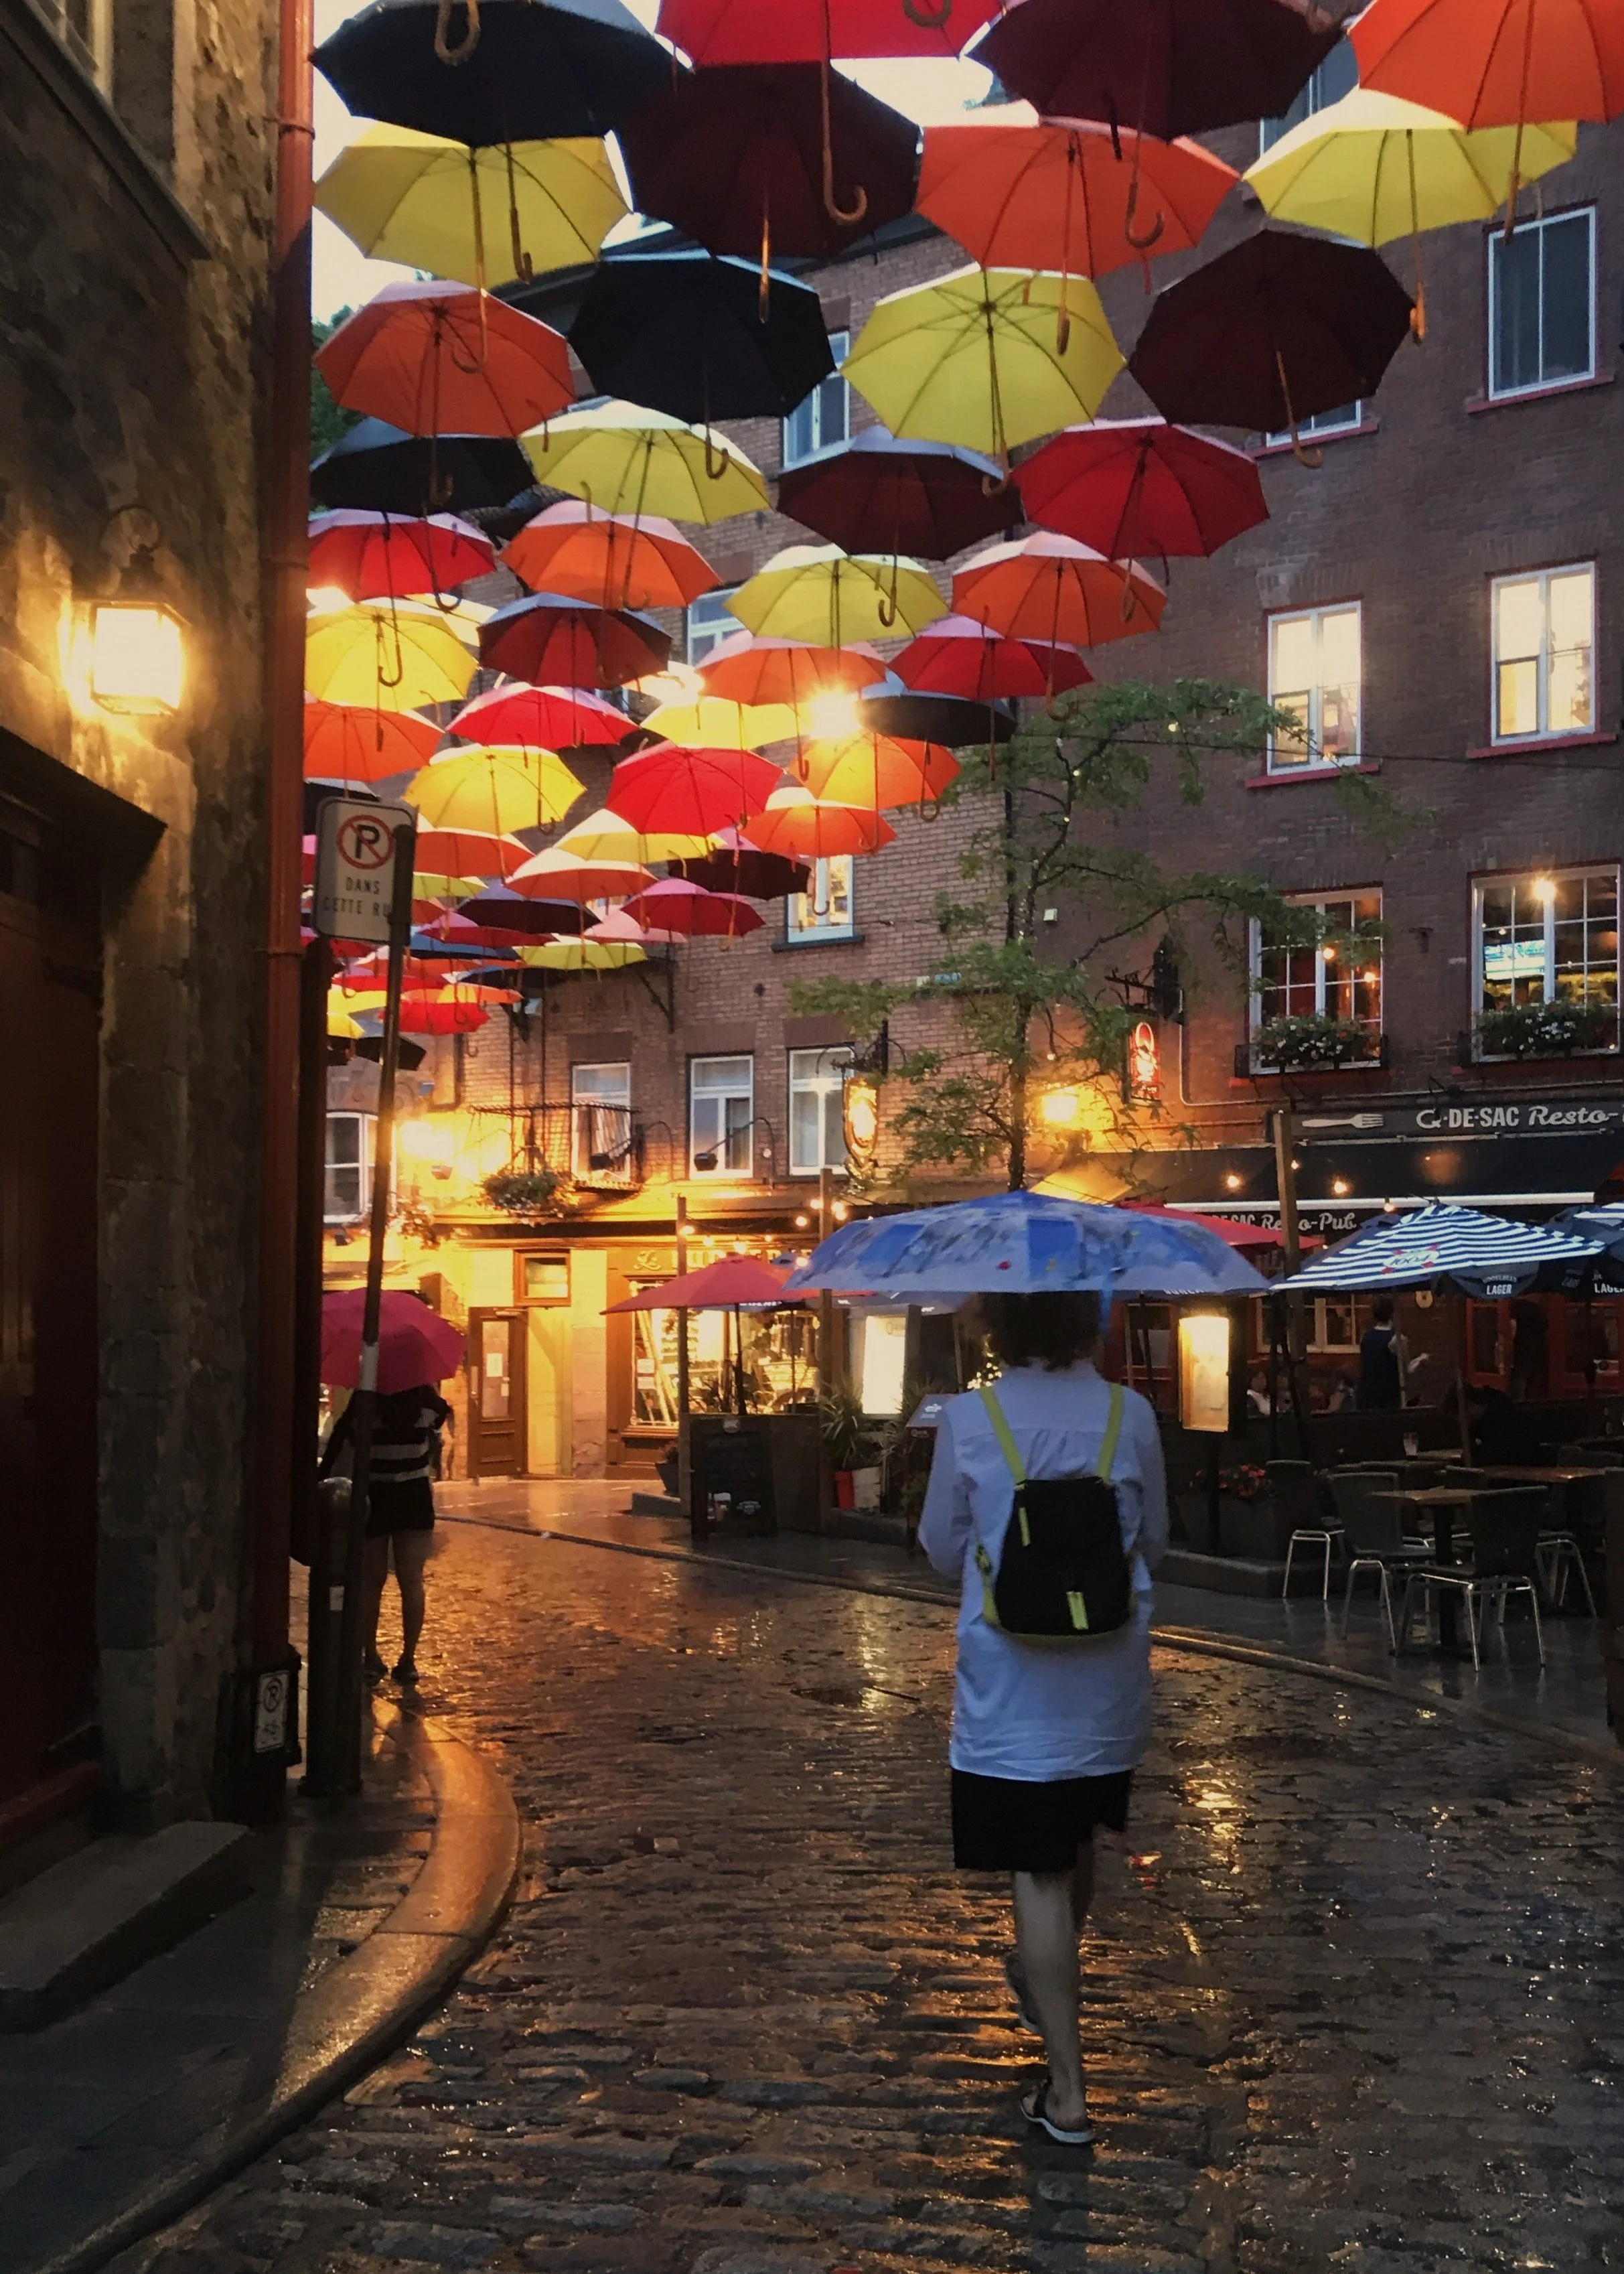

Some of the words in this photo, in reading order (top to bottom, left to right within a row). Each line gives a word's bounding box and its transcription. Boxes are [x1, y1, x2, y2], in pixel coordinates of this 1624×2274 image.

[346, 876, 380, 895] DANS
[323, 897, 362, 915] CETTE
[373, 902, 394, 918] RU
[1528, 1104, 1624, 1127] Resto-
[1262, 1212, 1357, 1231] Reo-Pub
[1486, 1283, 1512, 1295] LAGER
